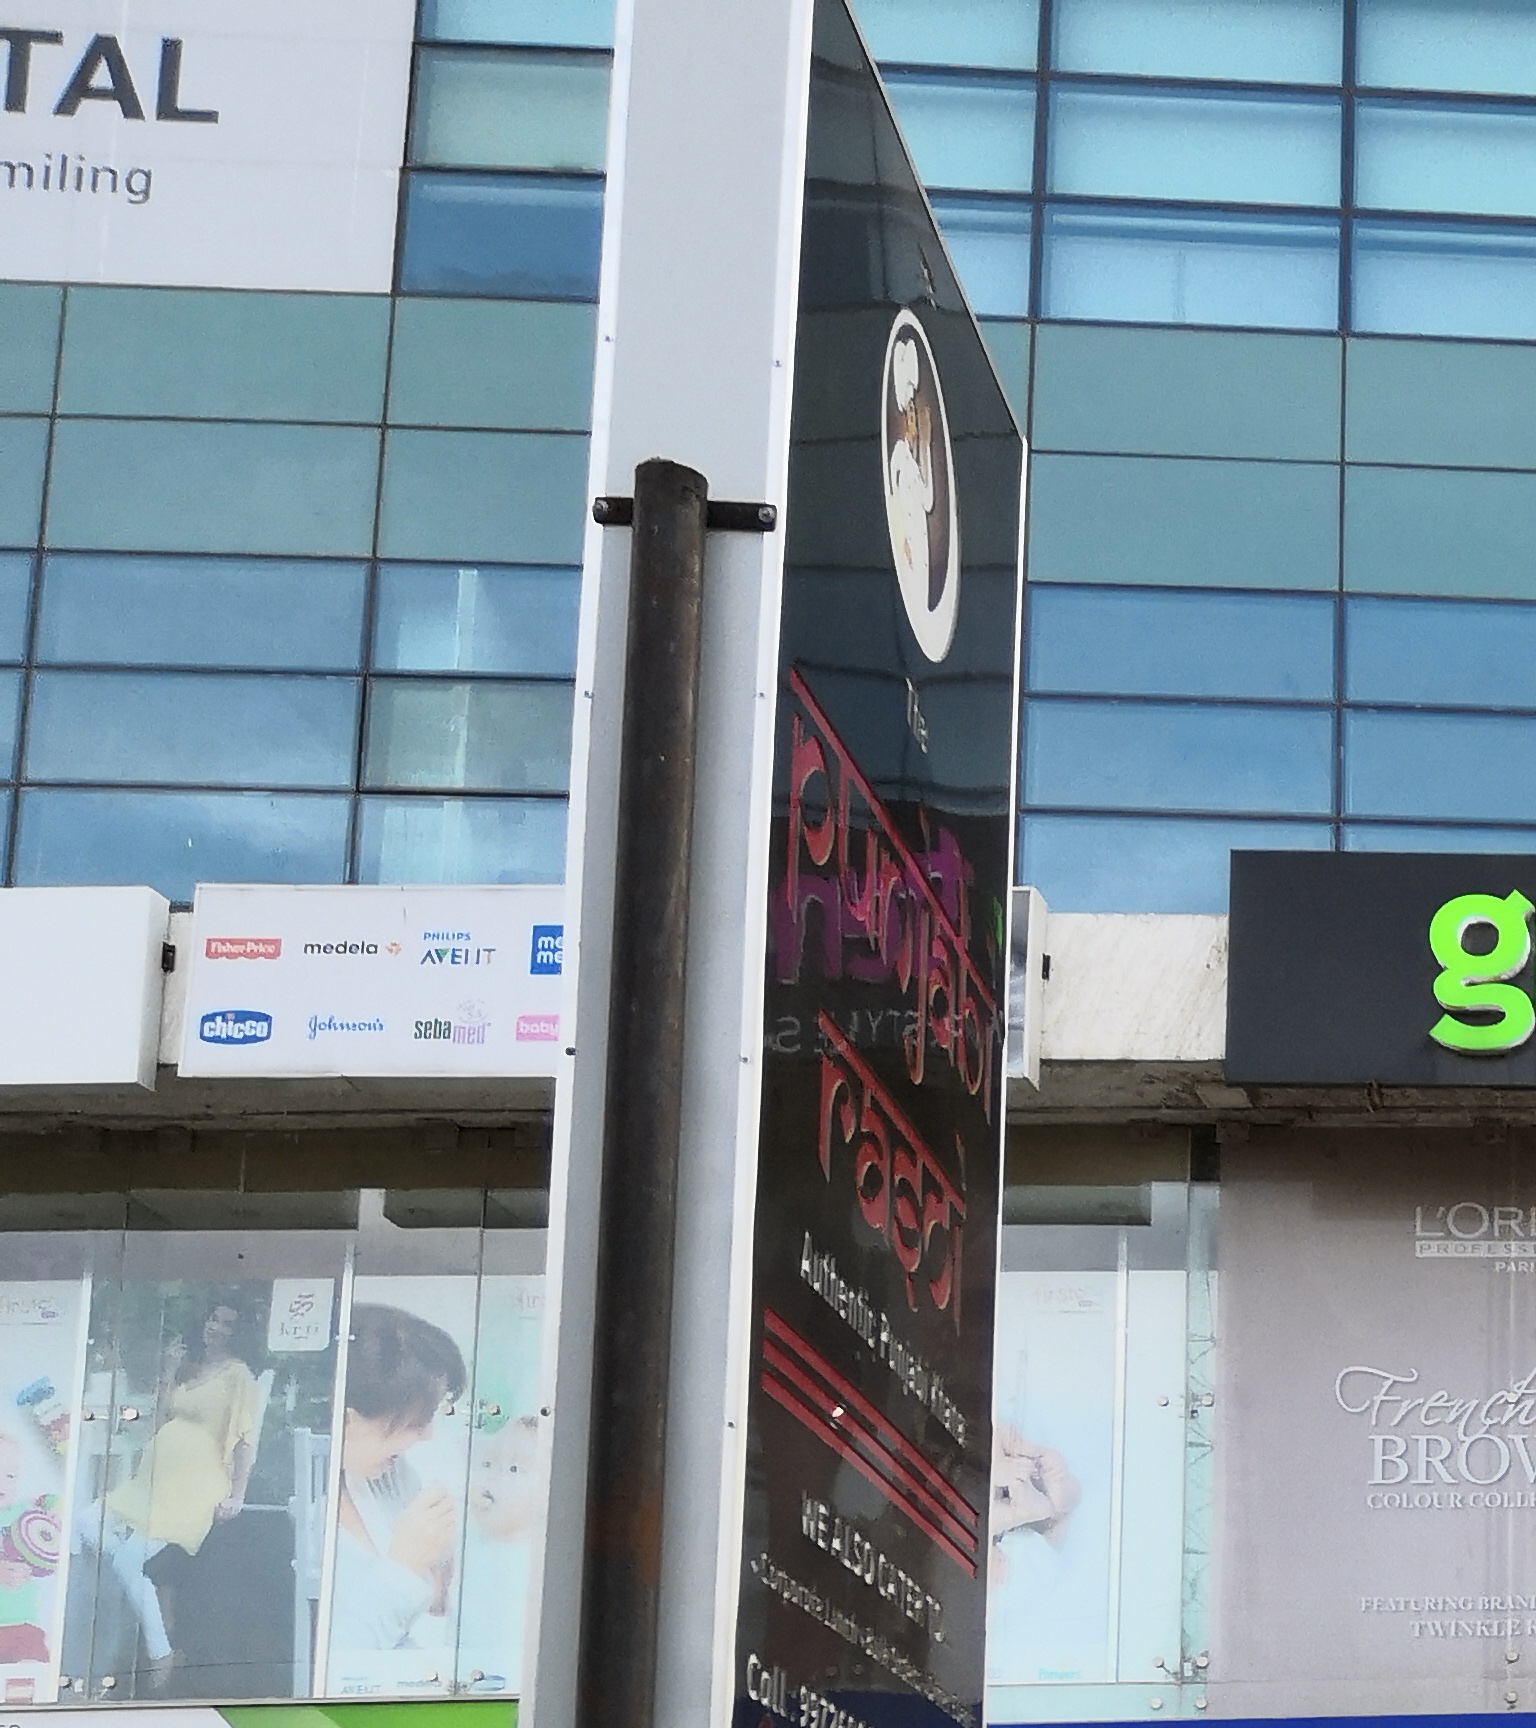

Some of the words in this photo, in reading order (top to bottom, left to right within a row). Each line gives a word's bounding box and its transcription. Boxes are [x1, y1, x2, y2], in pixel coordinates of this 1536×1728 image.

[423, 932, 472, 942] PHILIPS
[303, 940, 379, 955] medela
[202, 1013, 269, 1039] chicco
[1366, 1492, 1463, 1510] COLOUR
[1360, 1596, 1473, 1612] FEATURING
[1410, 1618, 1521, 1638] TWINKLE
